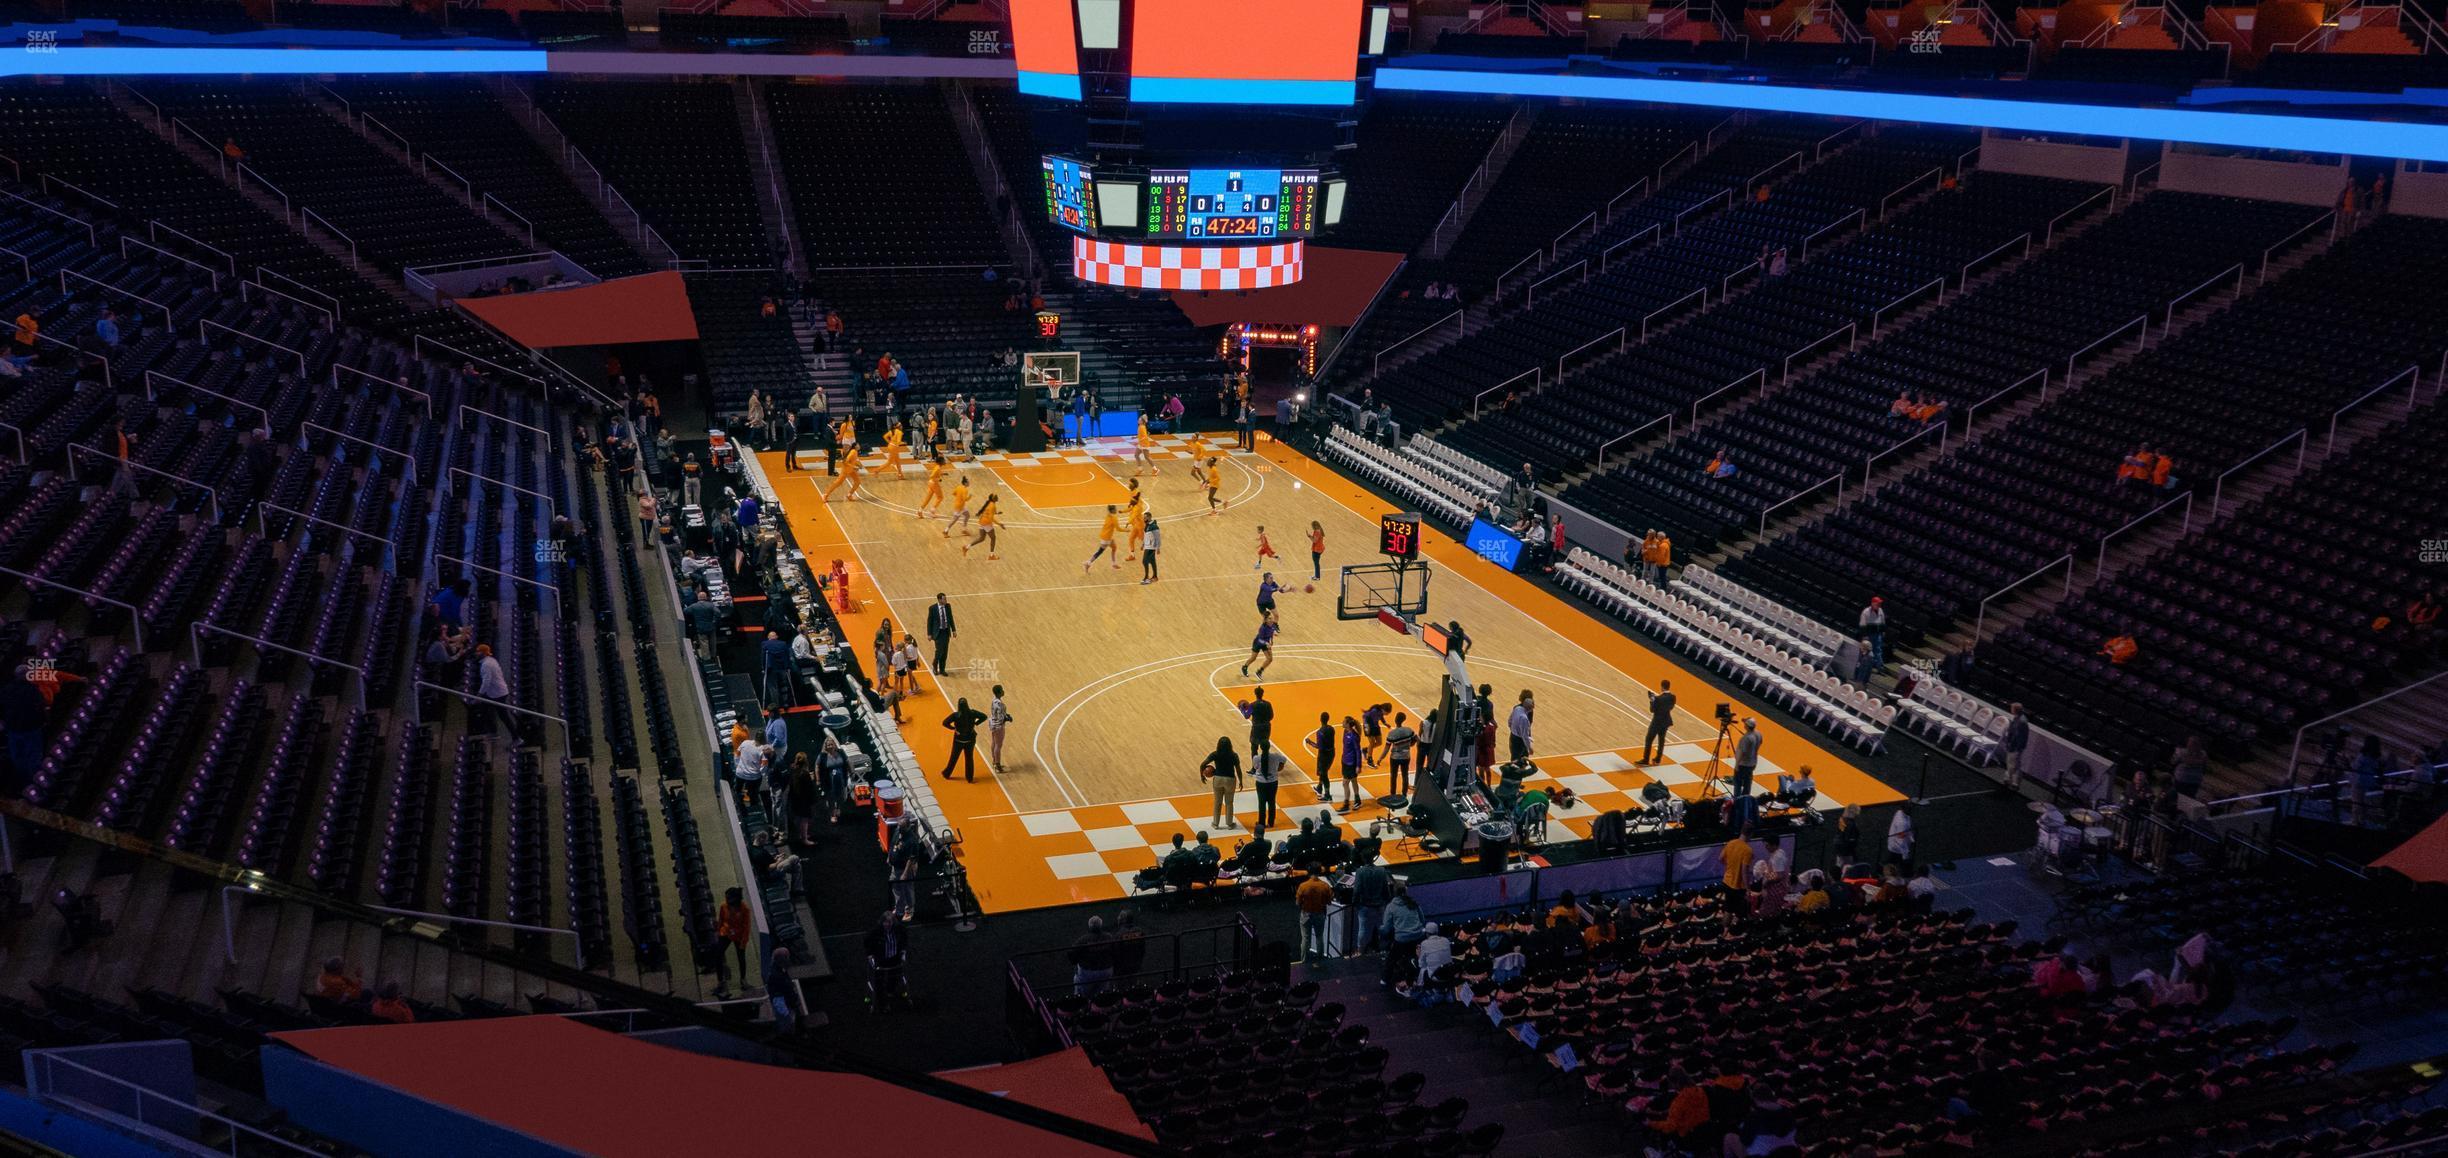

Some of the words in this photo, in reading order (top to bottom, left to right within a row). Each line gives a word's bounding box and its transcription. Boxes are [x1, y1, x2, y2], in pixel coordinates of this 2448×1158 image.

[1232, 180, 1238, 191] 1
[1284, 186, 1289, 194] 3
[1308, 186, 1314, 194] 0
[1151, 187, 1162, 195] 00
[1179, 186, 1185, 194] 9
[1177, 196, 1187, 204] 17
[1198, 198, 1205, 210] 0
[1262, 198, 1269, 210] 0
[1217, 203, 1223, 212] 4
[1243, 203, 1250, 212] 4
[1279, 214, 1288, 222] 21
[1164, 224, 1170, 232] 0
[1177, 224, 1183, 232] 0
[1207, 218, 1257, 234] 47:24
[1263, 226, 1270, 234] 0
[1278, 223, 1288, 231] 24
[1193, 227, 1200, 235] 0
[1039, 316, 1058, 324] 47:23
[1042, 323, 1056, 335] 30
[1384, 521, 1411, 535] 47:23
[1388, 532, 1406, 554] 30
